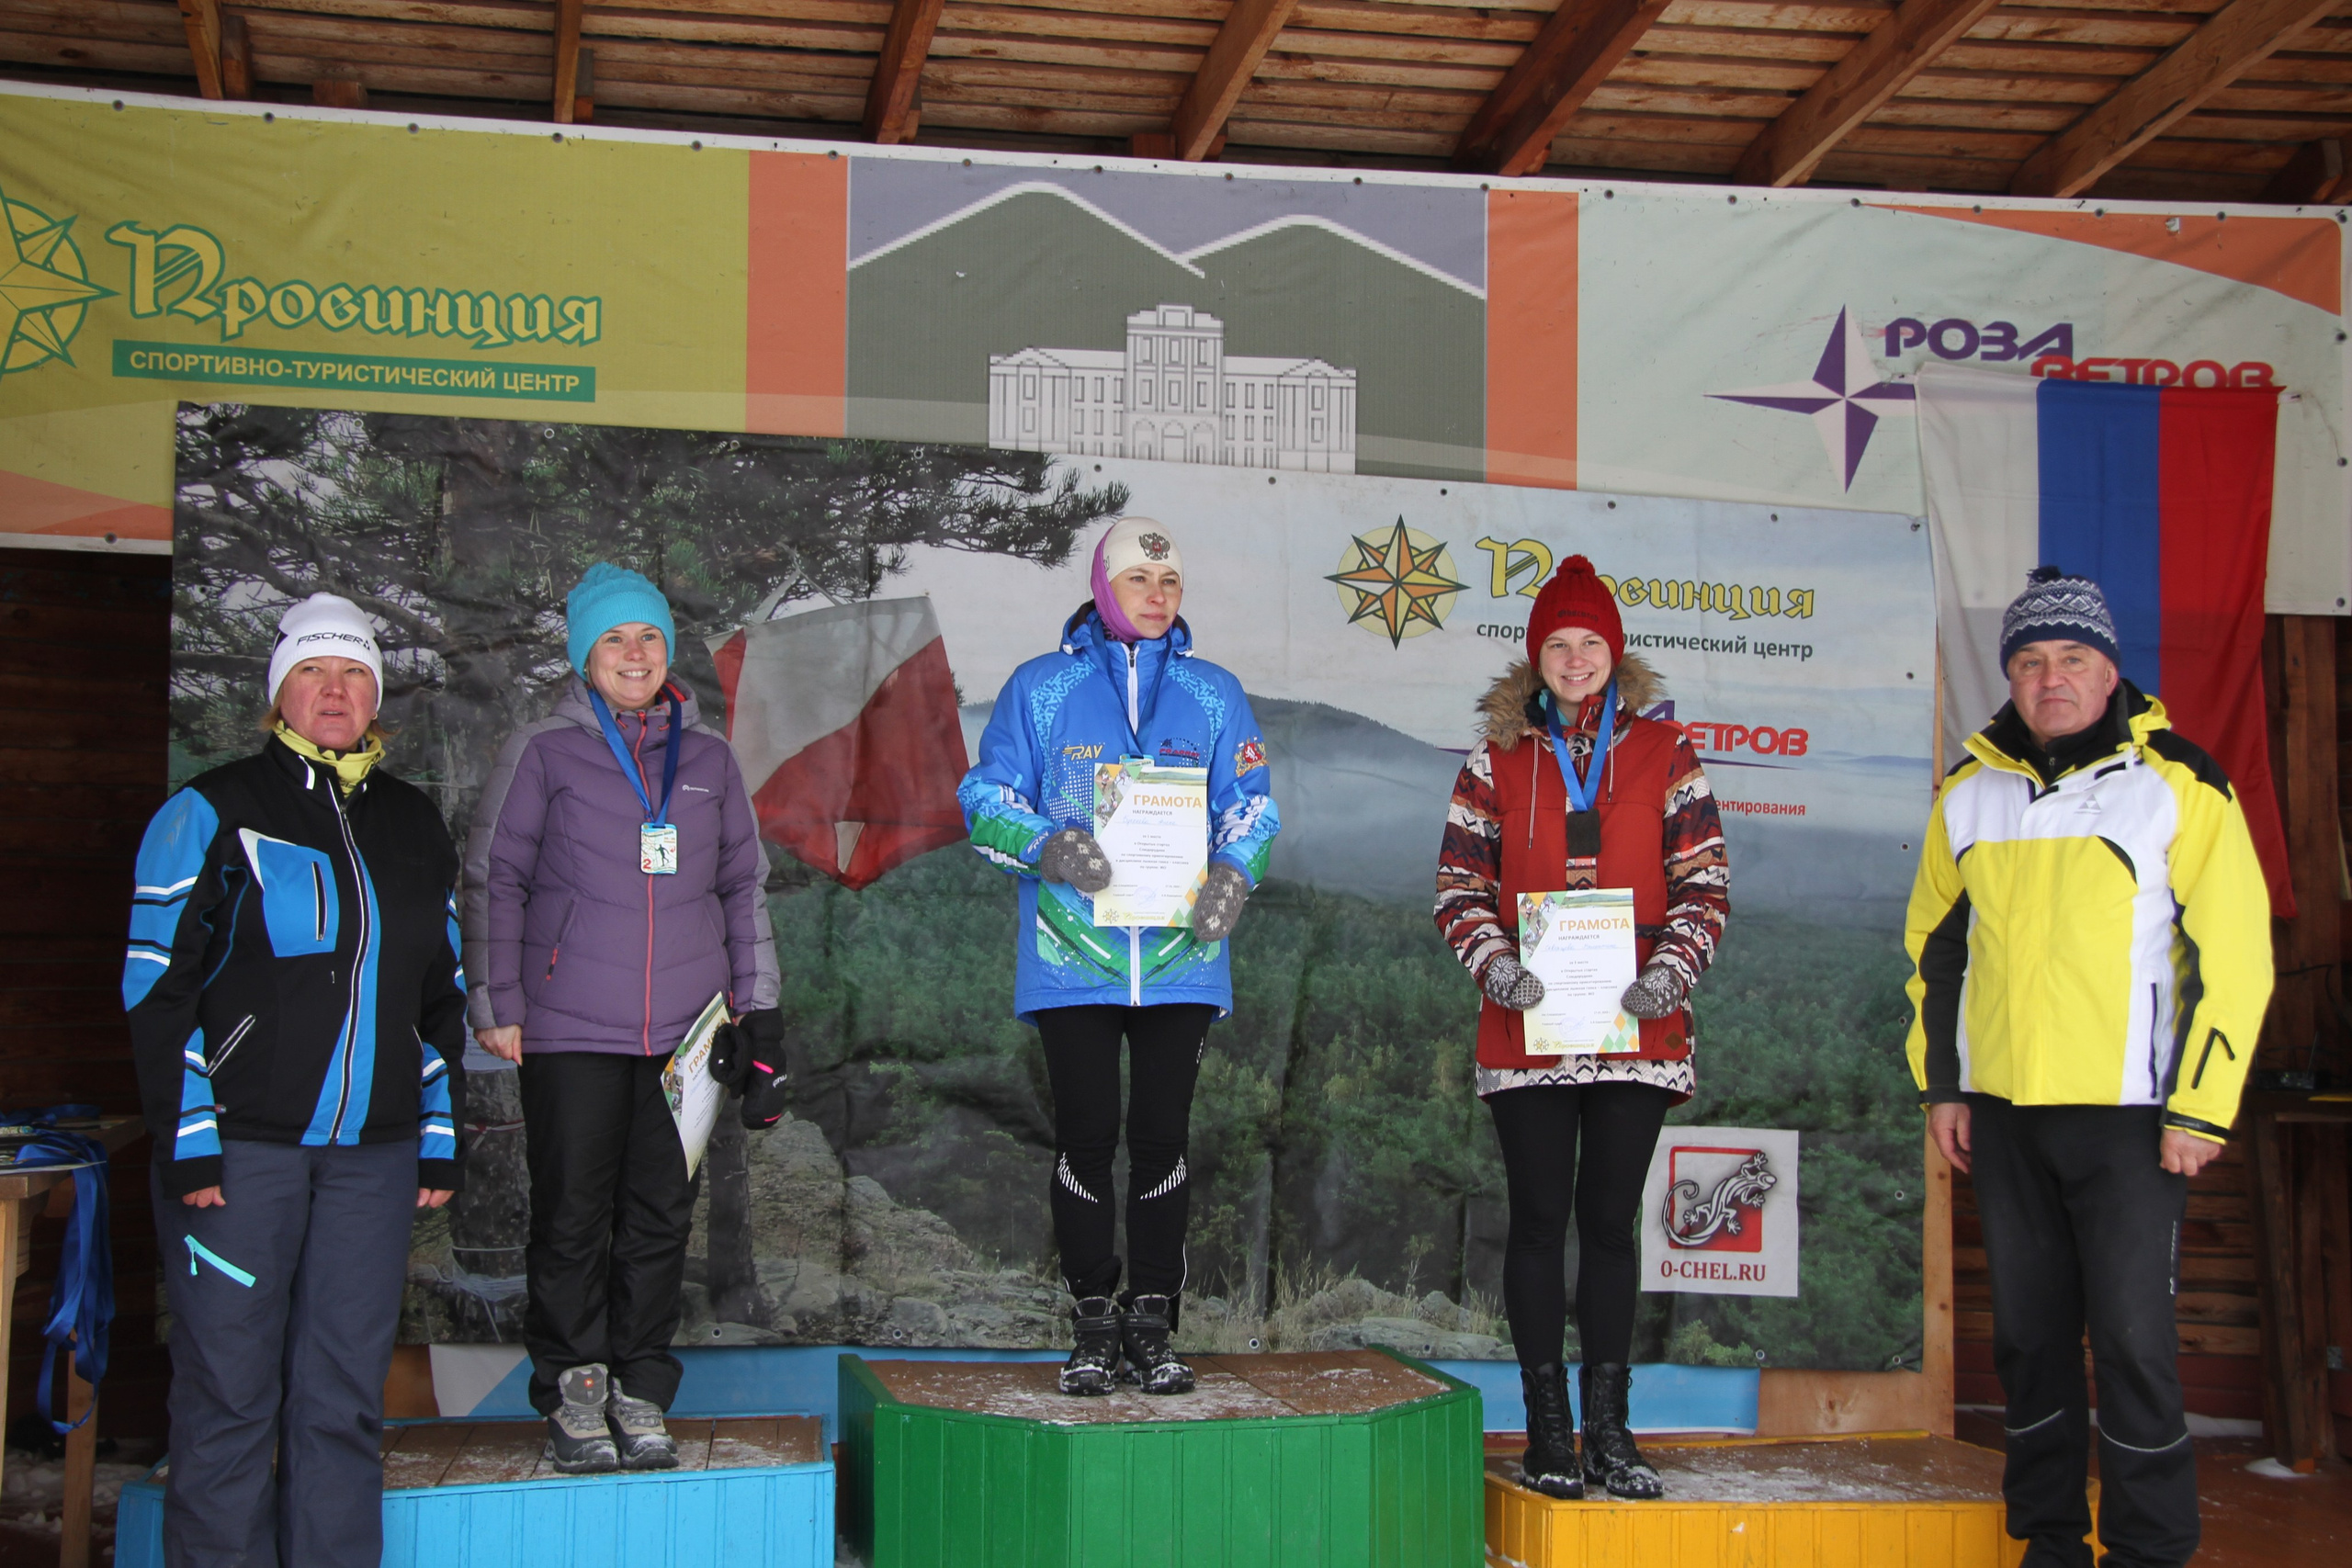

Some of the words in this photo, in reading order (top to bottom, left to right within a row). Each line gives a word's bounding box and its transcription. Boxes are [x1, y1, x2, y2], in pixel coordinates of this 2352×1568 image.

[104, 220, 601, 350] Провинция
[1885, 317, 2073, 361] РОЗА
[130, 351, 495, 389] СПОРТИВНО-ТУРИСТИЧЕСКИЙ
[503, 372, 580, 393] ЦЕНТР
[1475, 536, 1815, 620] Пвинция
[297, 632, 364, 647] FISCHER
[1753, 642, 1813, 661] центр
[1134, 795, 1203, 808] ГРАМОТА
[643, 858, 651, 869] 2
[1559, 918, 1630, 931] ГРАМОТА
